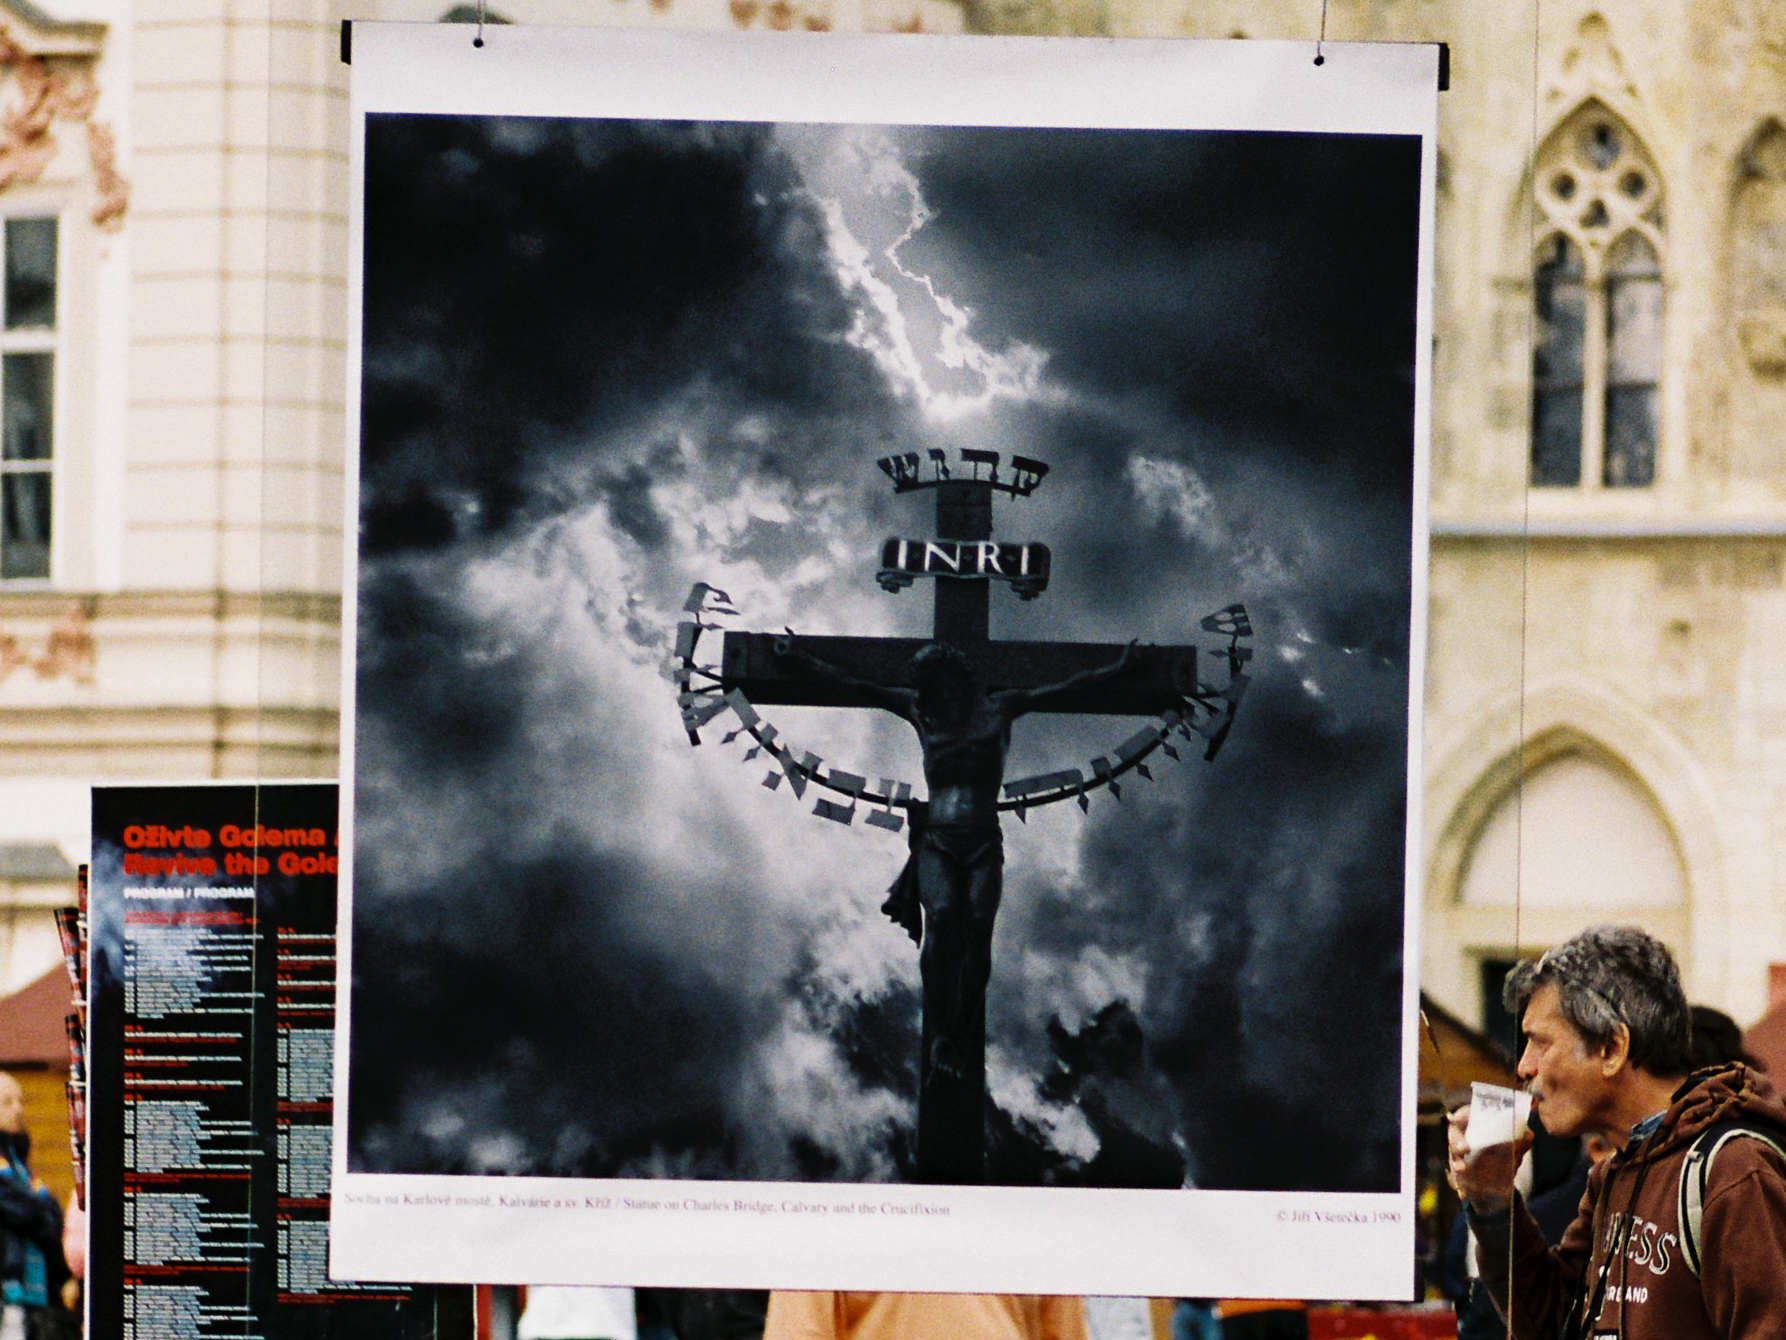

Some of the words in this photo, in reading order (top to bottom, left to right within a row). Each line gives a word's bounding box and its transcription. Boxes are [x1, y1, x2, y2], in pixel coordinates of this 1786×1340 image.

[897, 539, 1029, 575] INRI
[219, 824, 326, 848] Golema
[123, 852, 216, 876] Revive
[224, 852, 270, 876] the
[277, 851, 338, 876] Gole
[384, 1196, 399, 1205] na
[623, 1197, 660, 1210] Statue
[664, 1201, 680, 1210] on
[683, 1198, 730, 1211] Charles
[781, 1200, 829, 1215] Calvary
[832, 1201, 855, 1213] and
[858, 1201, 877, 1213] the
[880, 1202, 951, 1216] Crucifixion
